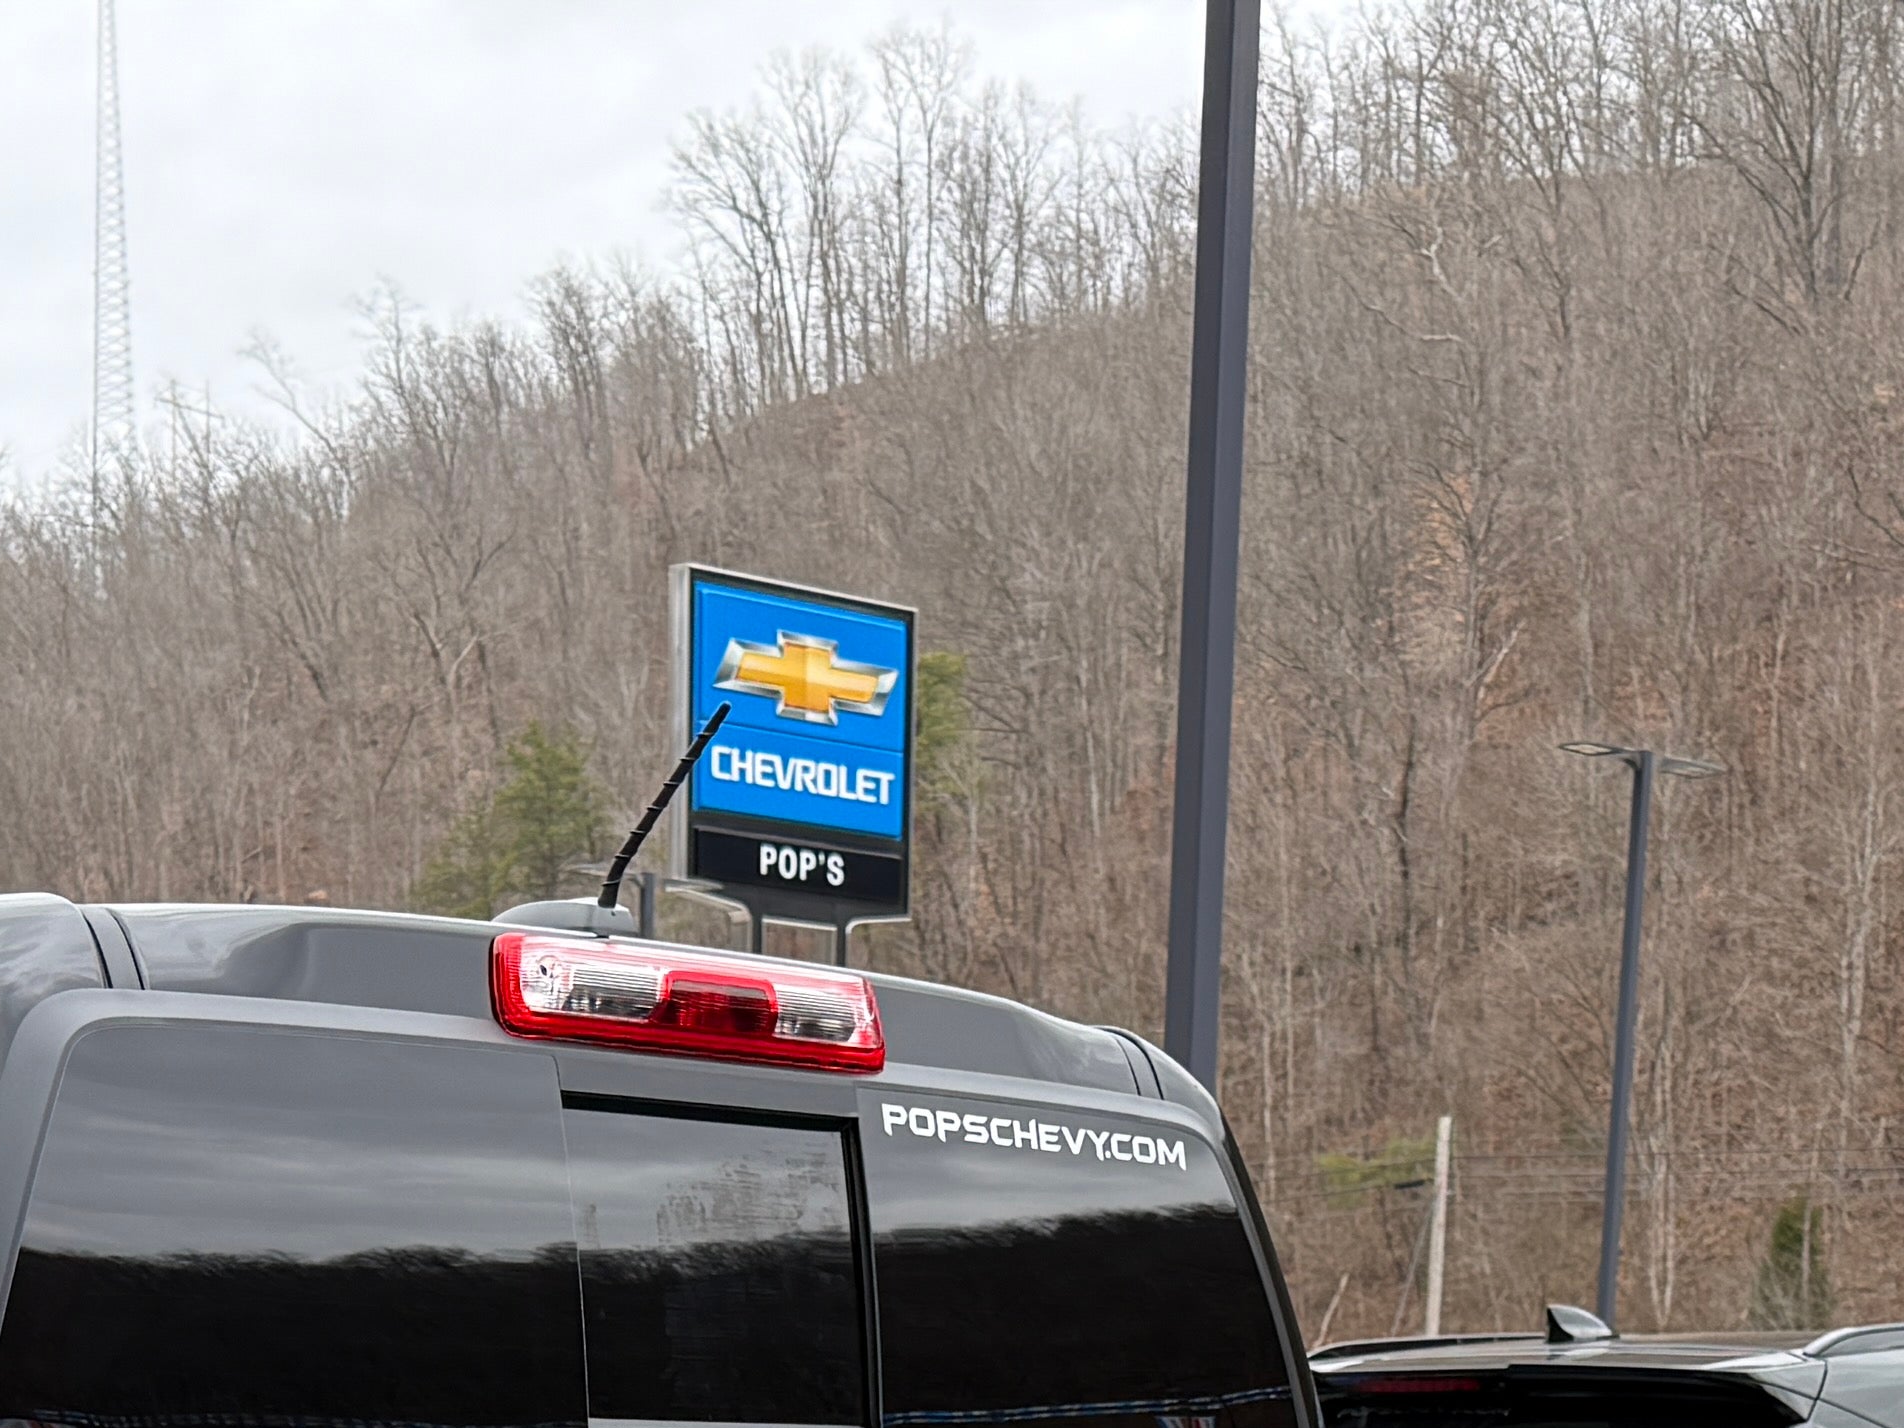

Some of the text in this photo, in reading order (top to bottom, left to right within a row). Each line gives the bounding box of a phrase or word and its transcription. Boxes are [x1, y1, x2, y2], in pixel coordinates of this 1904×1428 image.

[709, 744, 896, 807] CHEVROLET
[758, 842, 846, 887] POP'S
[881, 1102, 1188, 1172] POPSCHEVY.COM
